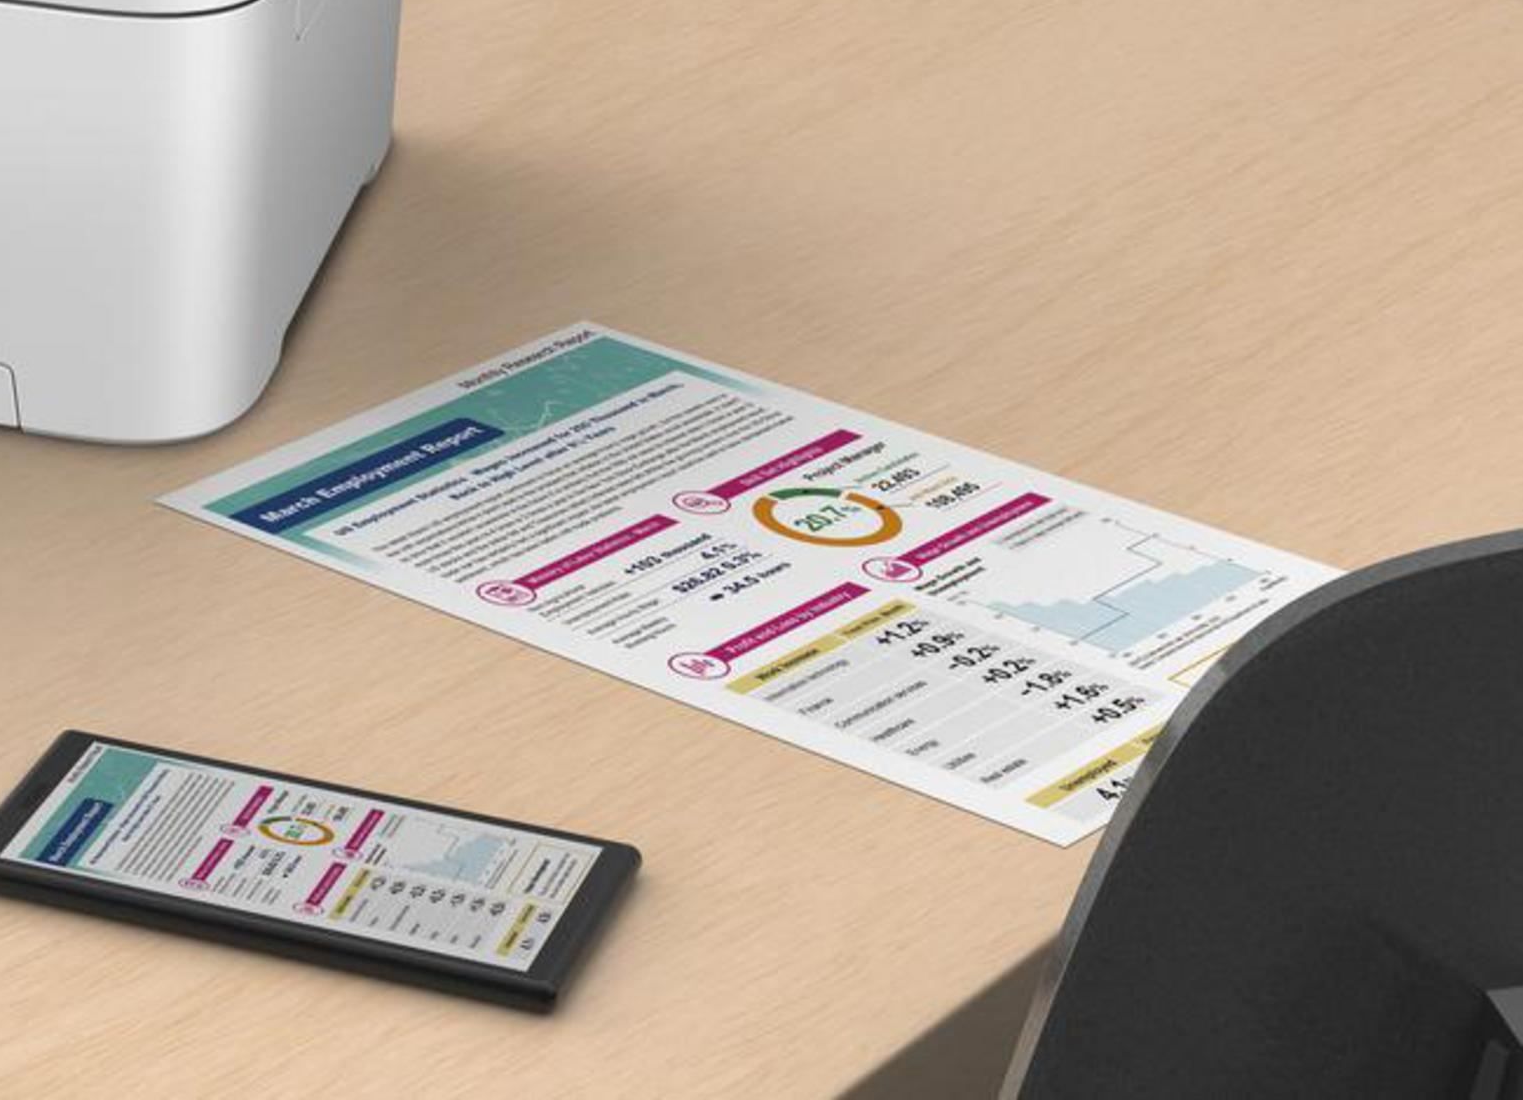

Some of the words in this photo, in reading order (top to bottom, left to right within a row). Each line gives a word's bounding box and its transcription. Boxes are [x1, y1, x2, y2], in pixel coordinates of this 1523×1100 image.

[255, 493, 328, 525] March
[311, 448, 432, 500] Employment
[414, 424, 490, 455] Report
[788, 499, 864, 533] 20.7%
[868, 615, 935, 648] +1.2%
[903, 627, 969, 660] +0.9%
[974, 653, 1040, 686] +0.2%
[1010, 665, 1076, 699] -1.8%
[1083, 691, 1150, 726] +0.5%
